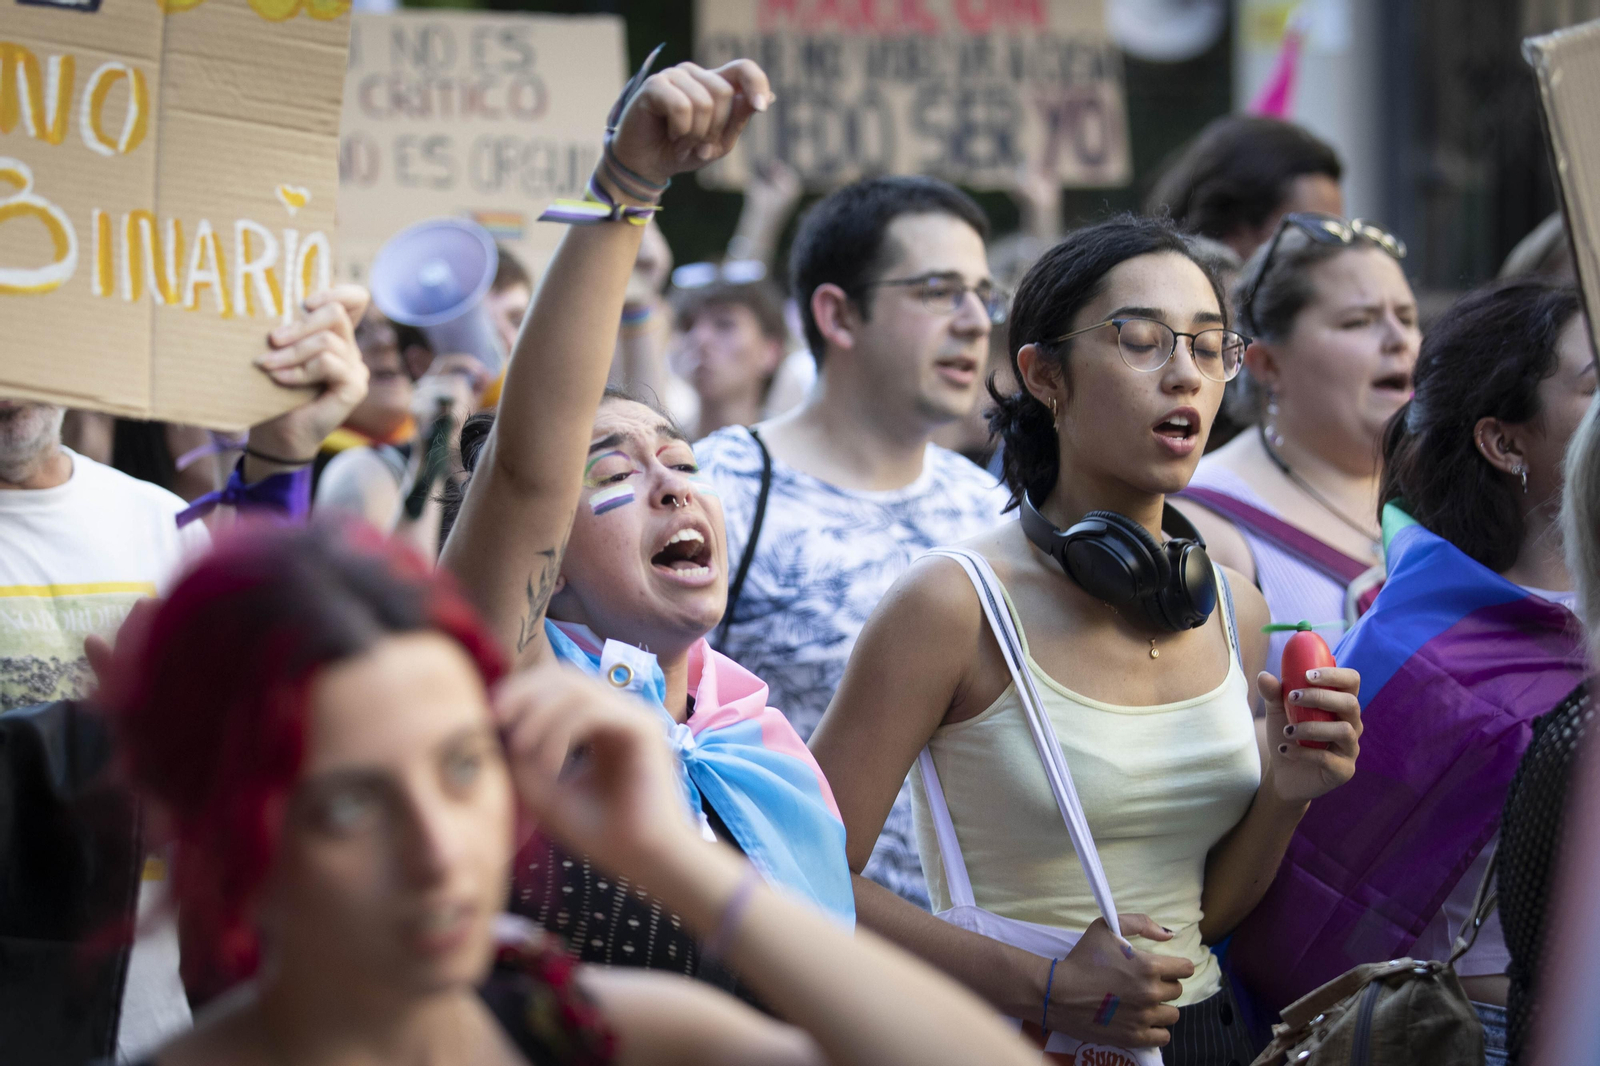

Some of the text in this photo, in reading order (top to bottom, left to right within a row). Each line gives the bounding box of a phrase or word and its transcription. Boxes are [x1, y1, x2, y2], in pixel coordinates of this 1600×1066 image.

[389, 23, 458, 72] NO
[469, 24, 538, 74] ES
[393, 133, 462, 191] ES
